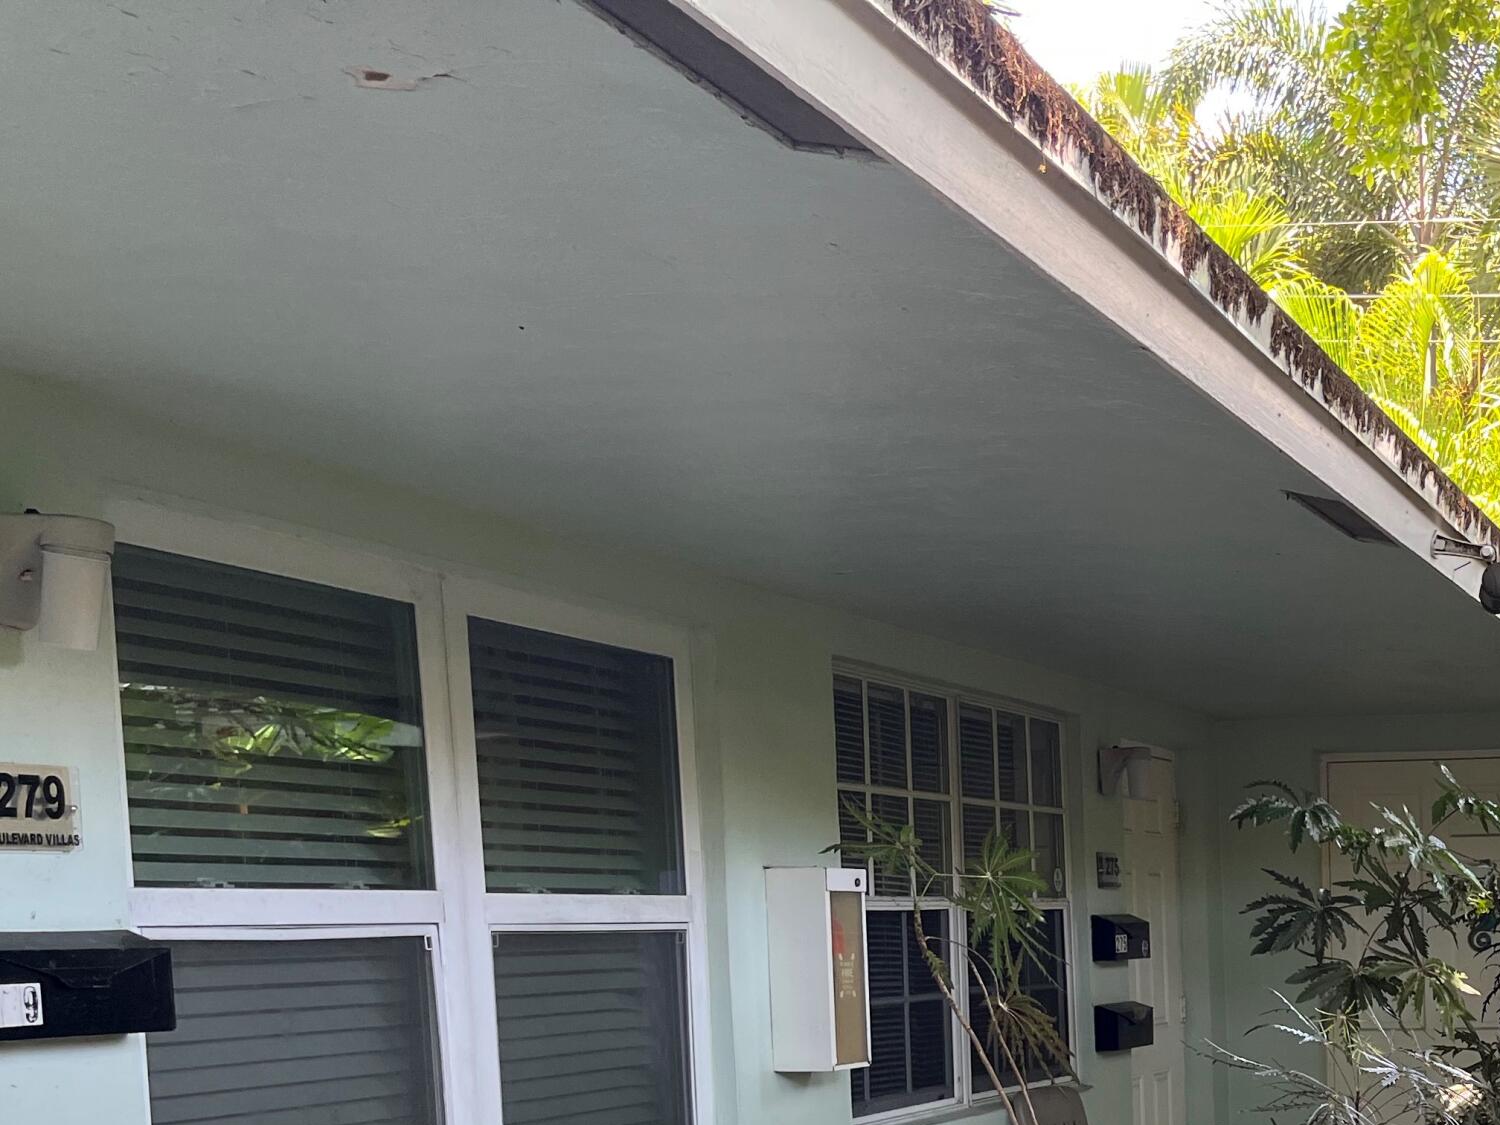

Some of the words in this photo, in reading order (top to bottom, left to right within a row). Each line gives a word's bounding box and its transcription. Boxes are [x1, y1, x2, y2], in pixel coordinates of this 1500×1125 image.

[0, 772, 65, 819] 279
[45, 833, 80, 847] VILLAS
[1115, 935, 1127, 953] 275
